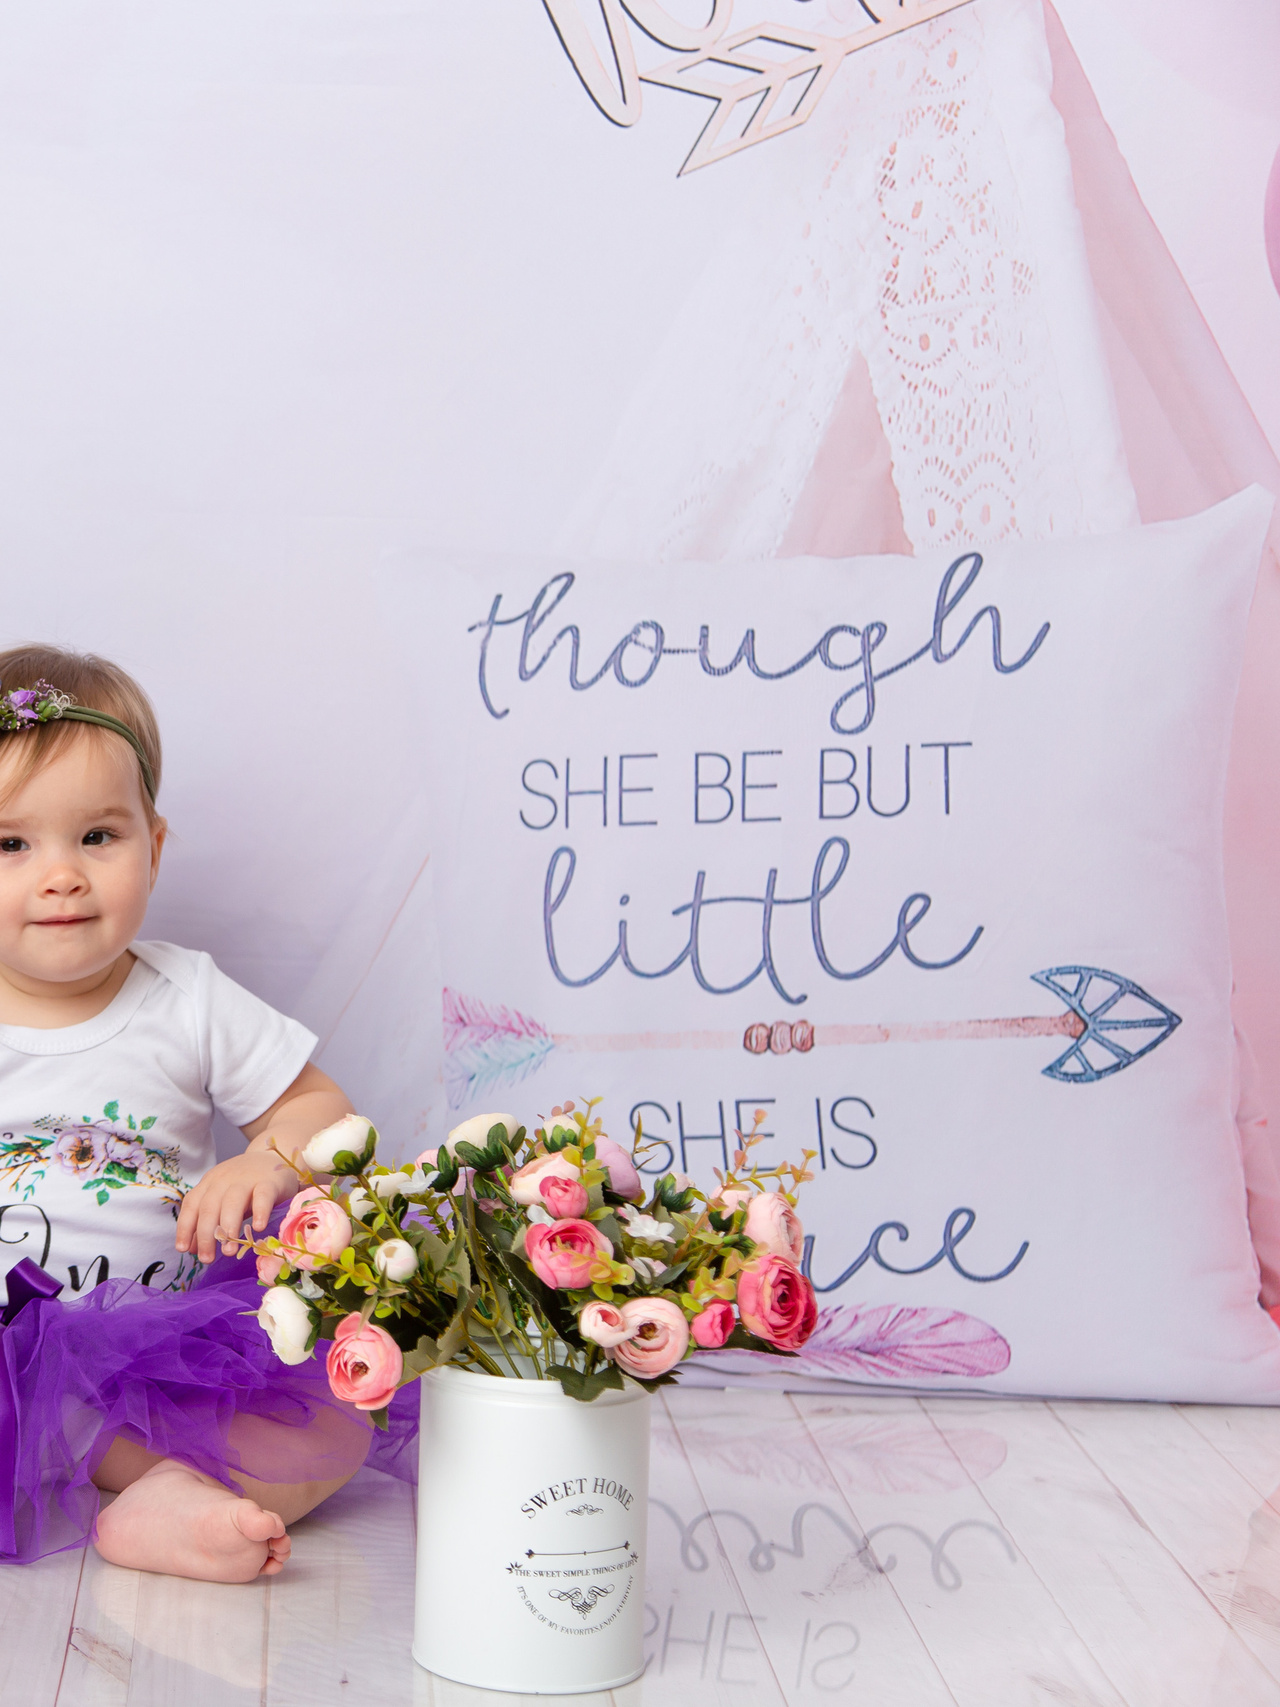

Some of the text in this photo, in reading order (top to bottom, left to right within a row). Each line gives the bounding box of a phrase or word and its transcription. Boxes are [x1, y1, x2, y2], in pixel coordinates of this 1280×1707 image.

[468, 552, 1050, 734] though
[520, 742, 973, 830] SHE BE BUT
[543, 836, 985, 1004] little
[629, 1096, 878, 1174] SHE IS
[520, 1477, 635, 1519] SWEET HOME
[514, 1569, 531, 1577] THE
[533, 1569, 562, 1578] SWEET
[562, 1568, 591, 1578] SIMPLE
[592, 1564, 617, 1576] THINGS
[524, 1600, 539, 1616] ONE
[537, 1614, 548, 1623] OF
[548, 1621, 558, 1631] MY
